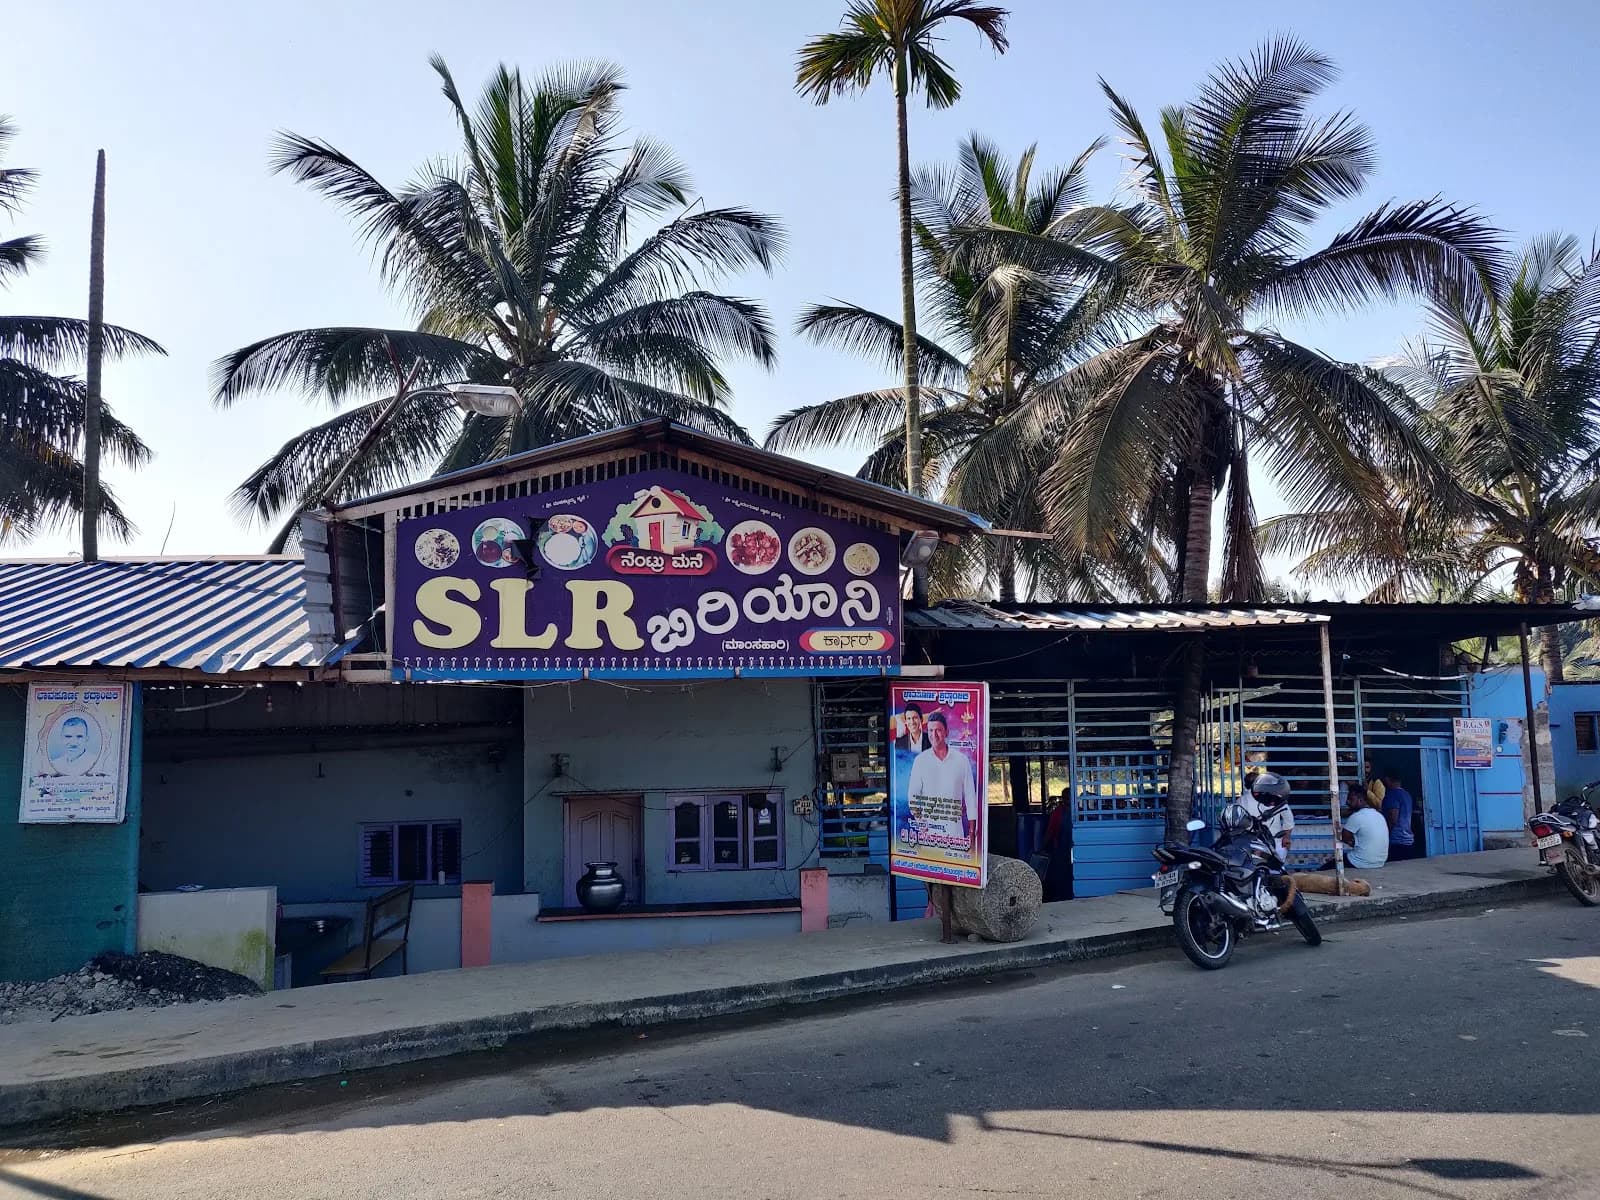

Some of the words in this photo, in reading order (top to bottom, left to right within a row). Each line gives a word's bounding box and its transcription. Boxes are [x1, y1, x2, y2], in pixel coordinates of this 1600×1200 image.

[671, 552, 704, 569] ಮನೆ
[412, 576, 645, 651] SLR
[646, 573, 881, 653] ಬಿರಿಯಾನಿ
[823, 635, 874, 649] ಕಾರ್ನರ್
